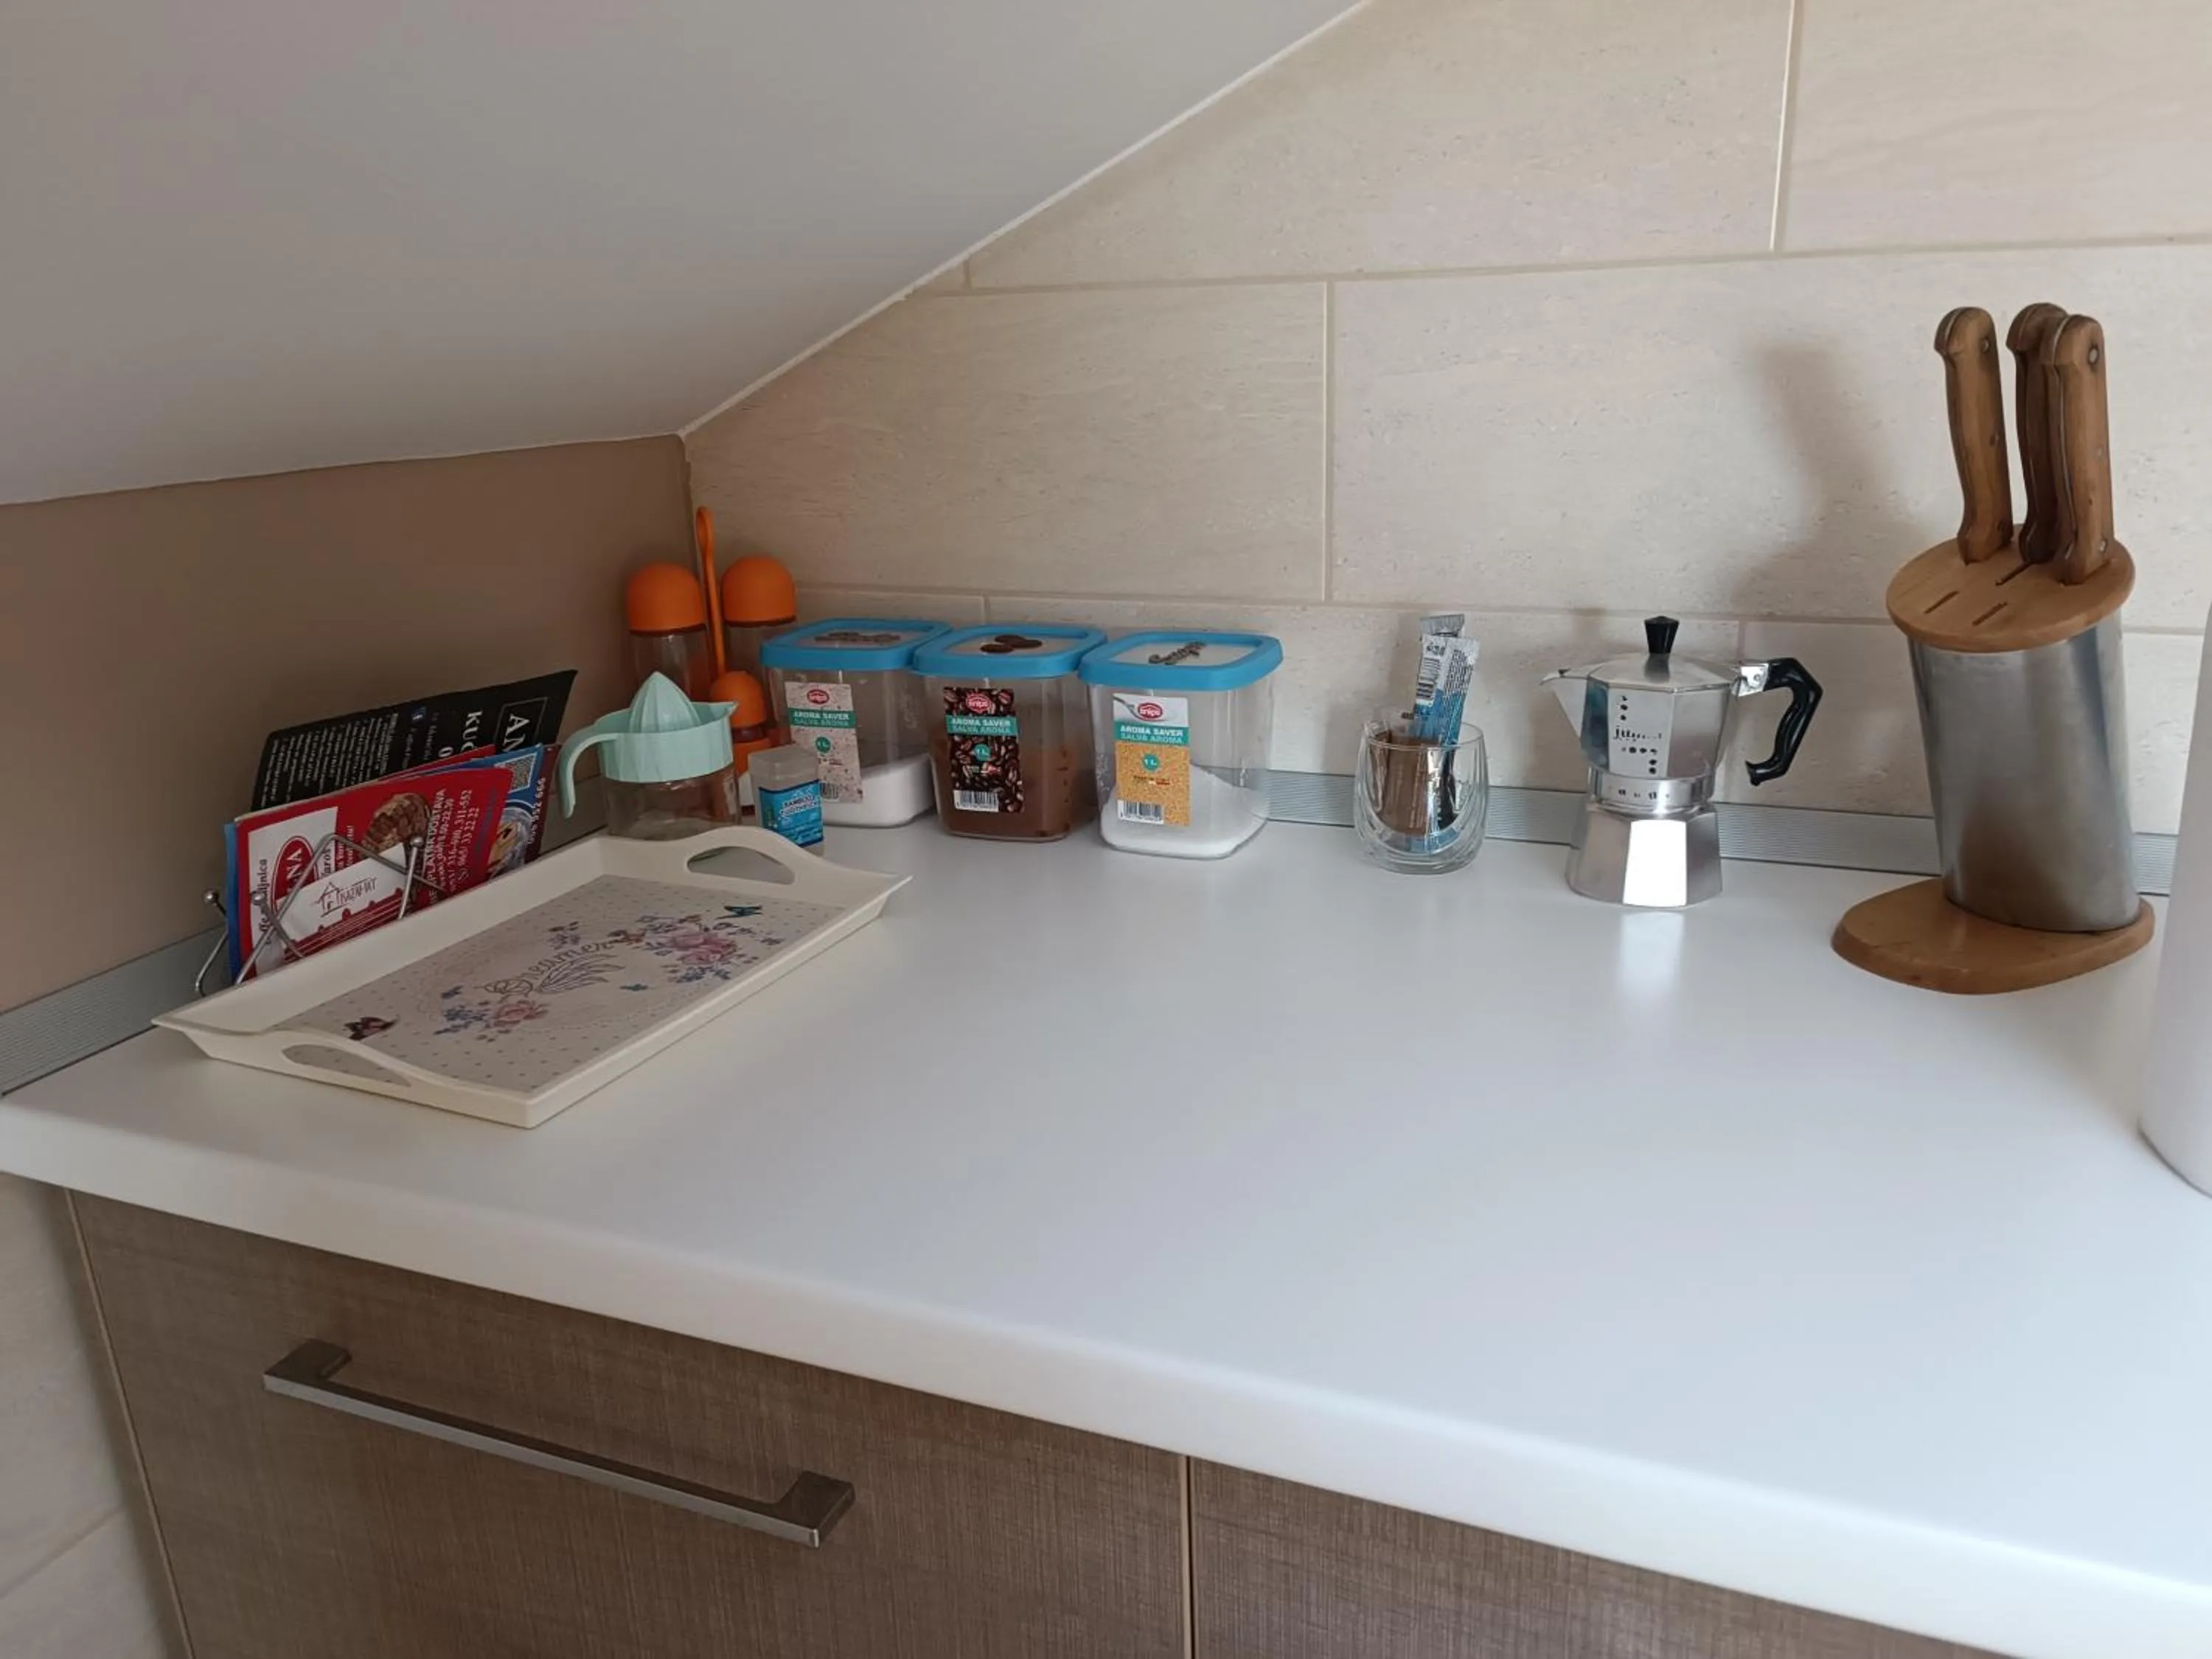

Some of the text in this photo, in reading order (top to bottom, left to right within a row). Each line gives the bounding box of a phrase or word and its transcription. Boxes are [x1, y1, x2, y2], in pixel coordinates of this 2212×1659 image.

[793, 711, 821, 719] AROMA
[952, 717, 981, 726] AROMA
[1120, 725, 1183, 737] AROMA SAVER
